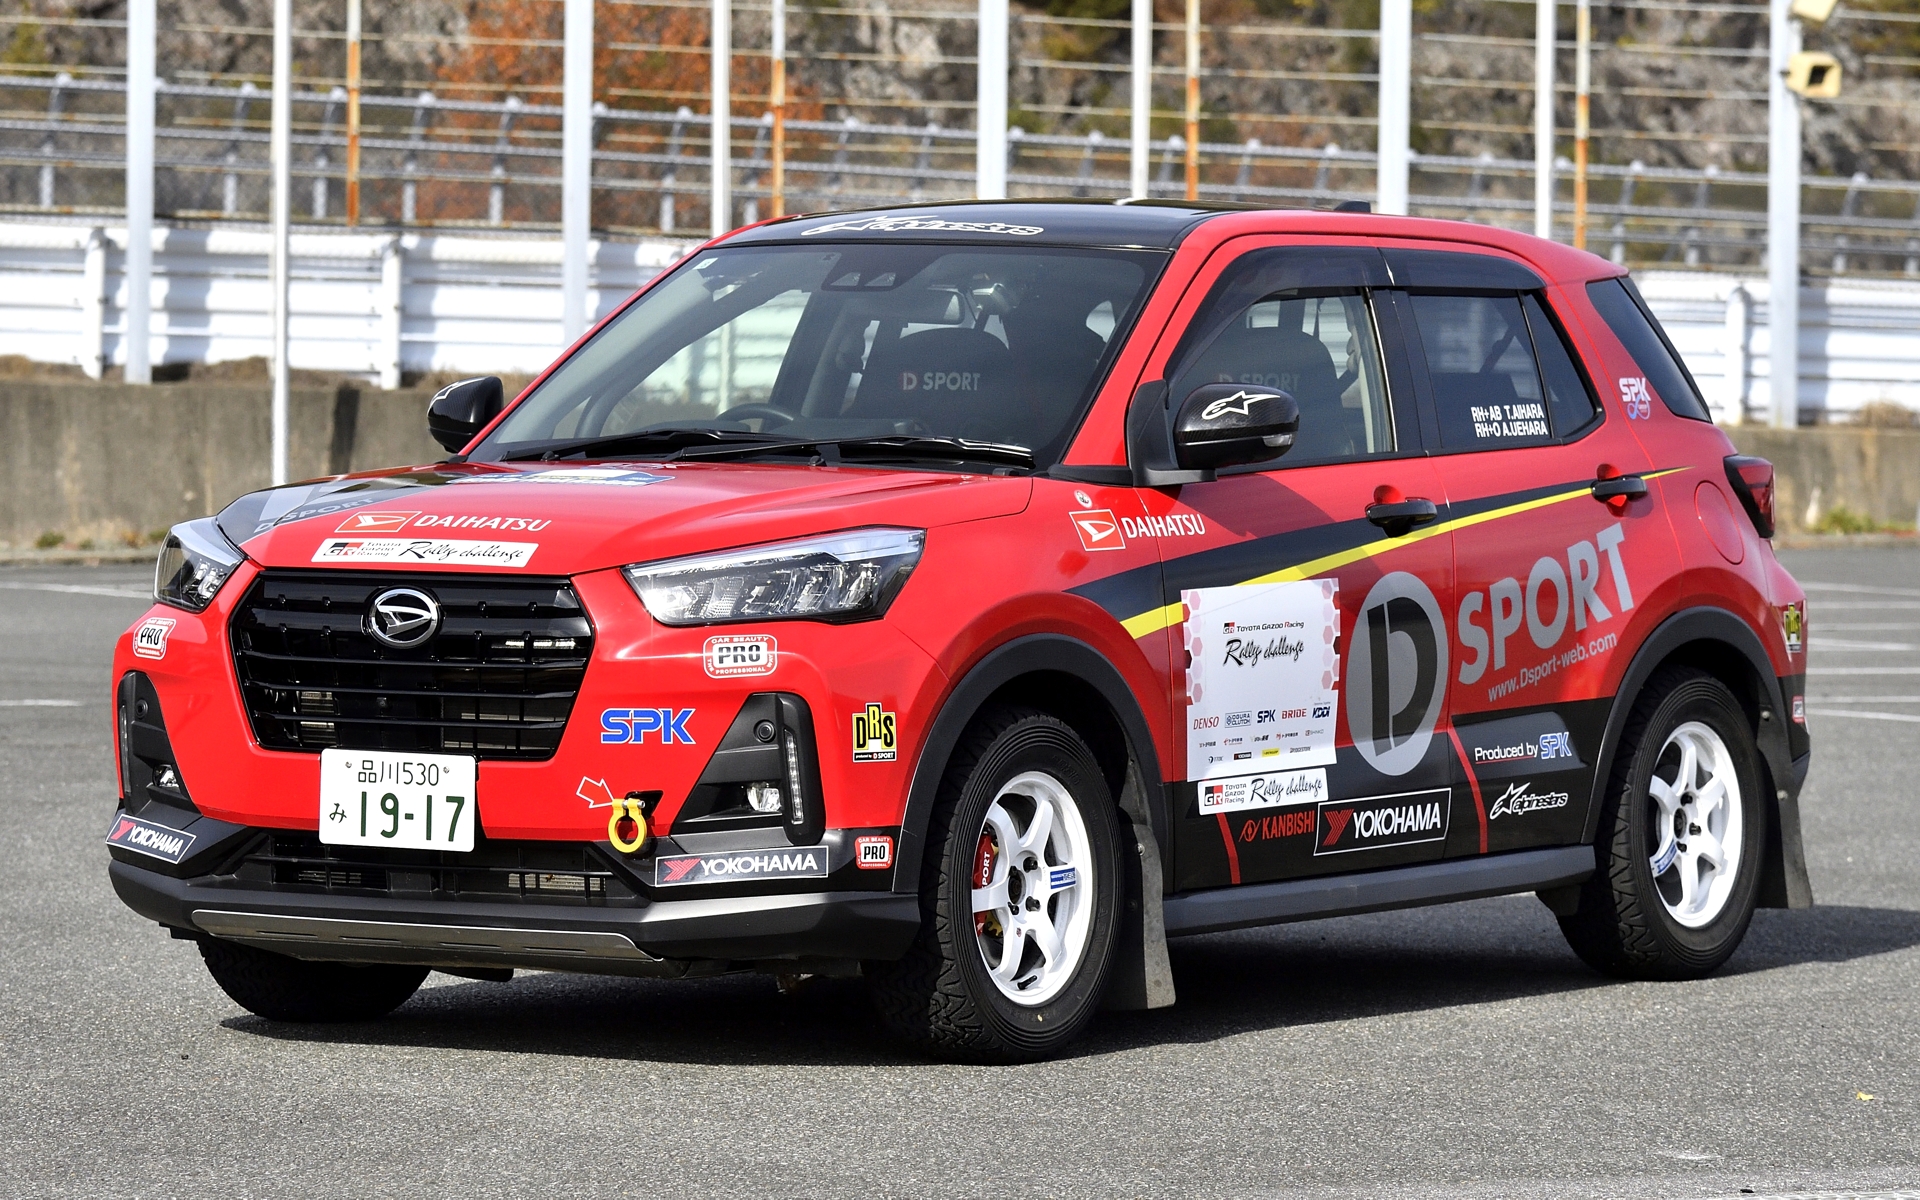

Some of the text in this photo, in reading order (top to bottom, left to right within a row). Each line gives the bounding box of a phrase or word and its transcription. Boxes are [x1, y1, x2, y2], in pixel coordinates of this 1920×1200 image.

[902, 371, 981, 391] D SPORT
[1618, 377, 1652, 402] SPK
[1470, 403, 1545, 422] RH+AB T.AIHARA
[1474, 421, 1549, 438] RH+O A.UEHARA
[281, 497, 376, 521] SPORT
[413, 514, 552, 532] DAIHATSU
[1120, 513, 1206, 539] DAIHATSU
[398, 540, 524, 563] Rally challenge
[140, 627, 163, 645] PRO
[1284, 621, 1305, 629] Racing
[1222, 634, 1305, 667] Rally challenge
[1366, 521, 1635, 757] D SPORT
[718, 644, 761, 665] PRO
[715, 666, 766, 675] PROFESSIONAL
[1488, 632, 1618, 702] www.Dsport-web.com
[1193, 716, 1220, 730] DENSO
[1257, 709, 1276, 724] SPK
[1281, 708, 1307, 720] BRIDE
[600, 708, 697, 745] SPK
[855, 705, 894, 749] DRS
[1474, 731, 1573, 761] Produced by SPK
[1224, 796, 1245, 804] Racing
[1249, 774, 1323, 803] Rally challenge
[329, 791, 466, 842] み 19-17
[1261, 810, 1316, 840] KANBISHI
[1352, 802, 1442, 839] YOKOHAMA
[127, 825, 185, 856] YOKOHAMA
[863, 845, 886, 860] PRO
[700, 853, 819, 876] YOKOHAMA
[982, 851, 991, 889] PORT
